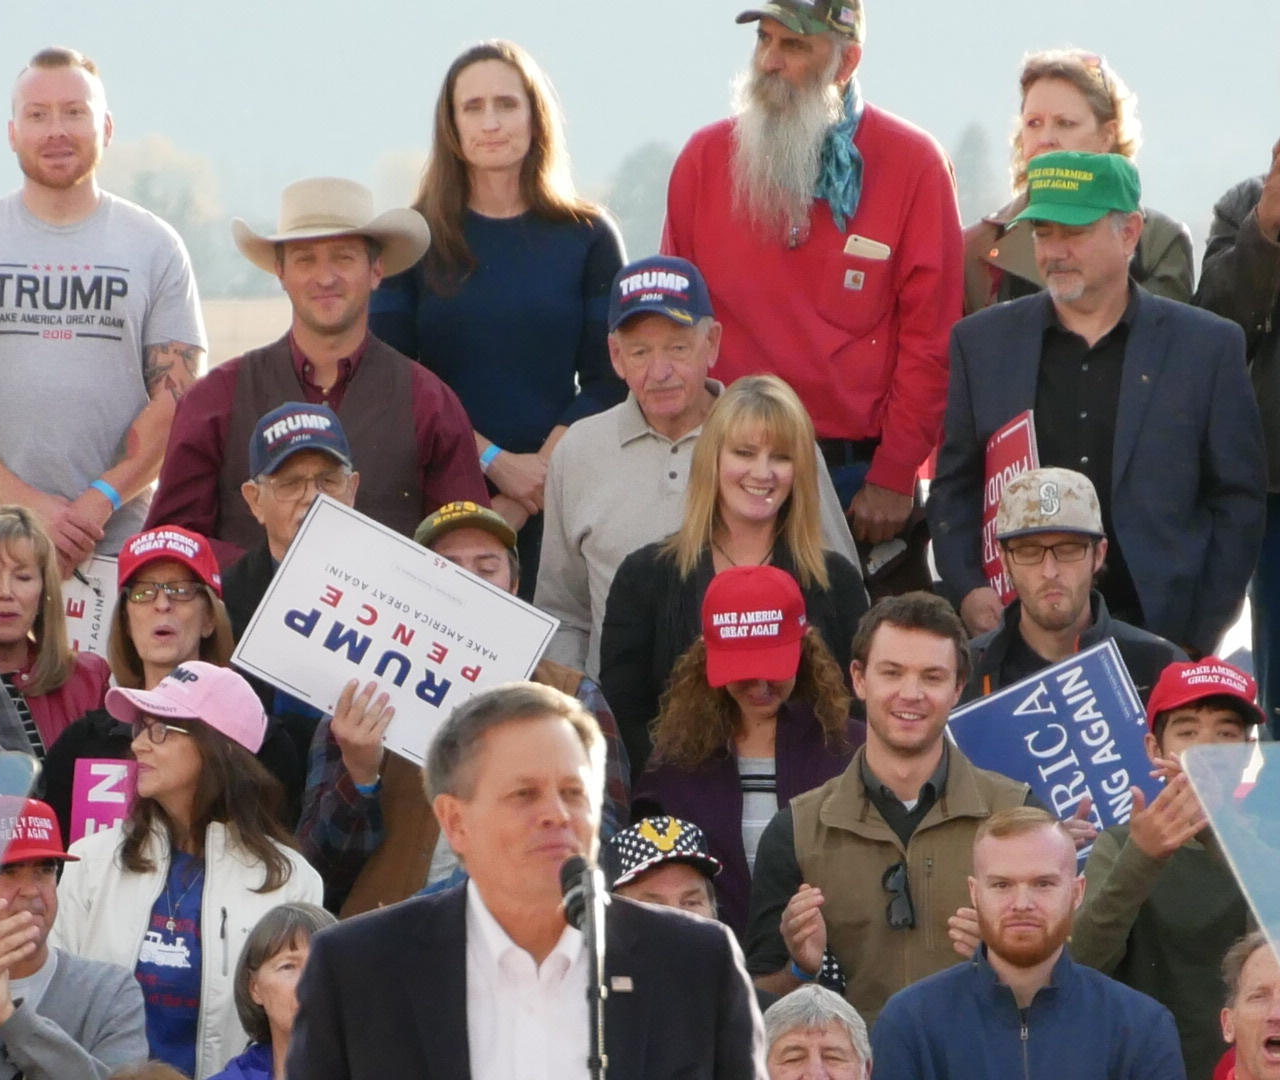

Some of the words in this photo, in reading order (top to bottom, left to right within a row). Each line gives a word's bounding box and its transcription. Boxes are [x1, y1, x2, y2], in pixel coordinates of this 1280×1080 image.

[1056, 168, 1093, 181] FARMERS
[1052, 180, 1079, 190] AGAIN!
[619, 271, 689, 296] TRUMP
[640, 293, 663, 302] 2016
[20, 313, 63, 325] AMERICA
[66, 314, 96, 327] GREAT
[99, 316, 124, 329] AGAIN
[42, 329, 72, 340] 2016
[263, 414, 331, 444] TRUMP
[290, 434, 311, 445] 2016
[130, 532, 155, 552] MAKE
[156, 531, 199, 552] AMERICA
[134, 540, 165, 556] GREAT
[166, 540, 194, 558] AGAIN
[433, 557, 449, 570] 45
[325, 563, 369, 590] AGAIN!
[371, 588, 411, 613] GREAT
[413, 609, 465, 643] AMERICA
[712, 613, 738, 626] MAKE
[739, 609, 783, 623] AMERICA
[319, 584, 482, 683] PENCE
[720, 626, 749, 639] GREAT
[750, 623, 779, 637] AGAIN
[283, 607, 452, 708] RUMP
[466, 639, 498, 662] MAKE
[1181, 666, 1210, 679] MAKE
[1211, 666, 1248, 686] AMERICA
[1188, 675, 1220, 685] GREAT
[1220, 676, 1246, 693] AGAIN
[1056, 666, 1122, 767] AGAIN
[10, 818, 26, 829] FLY
[28, 817, 53, 830] FISHING
[27, 828, 49, 840] AGAIN
